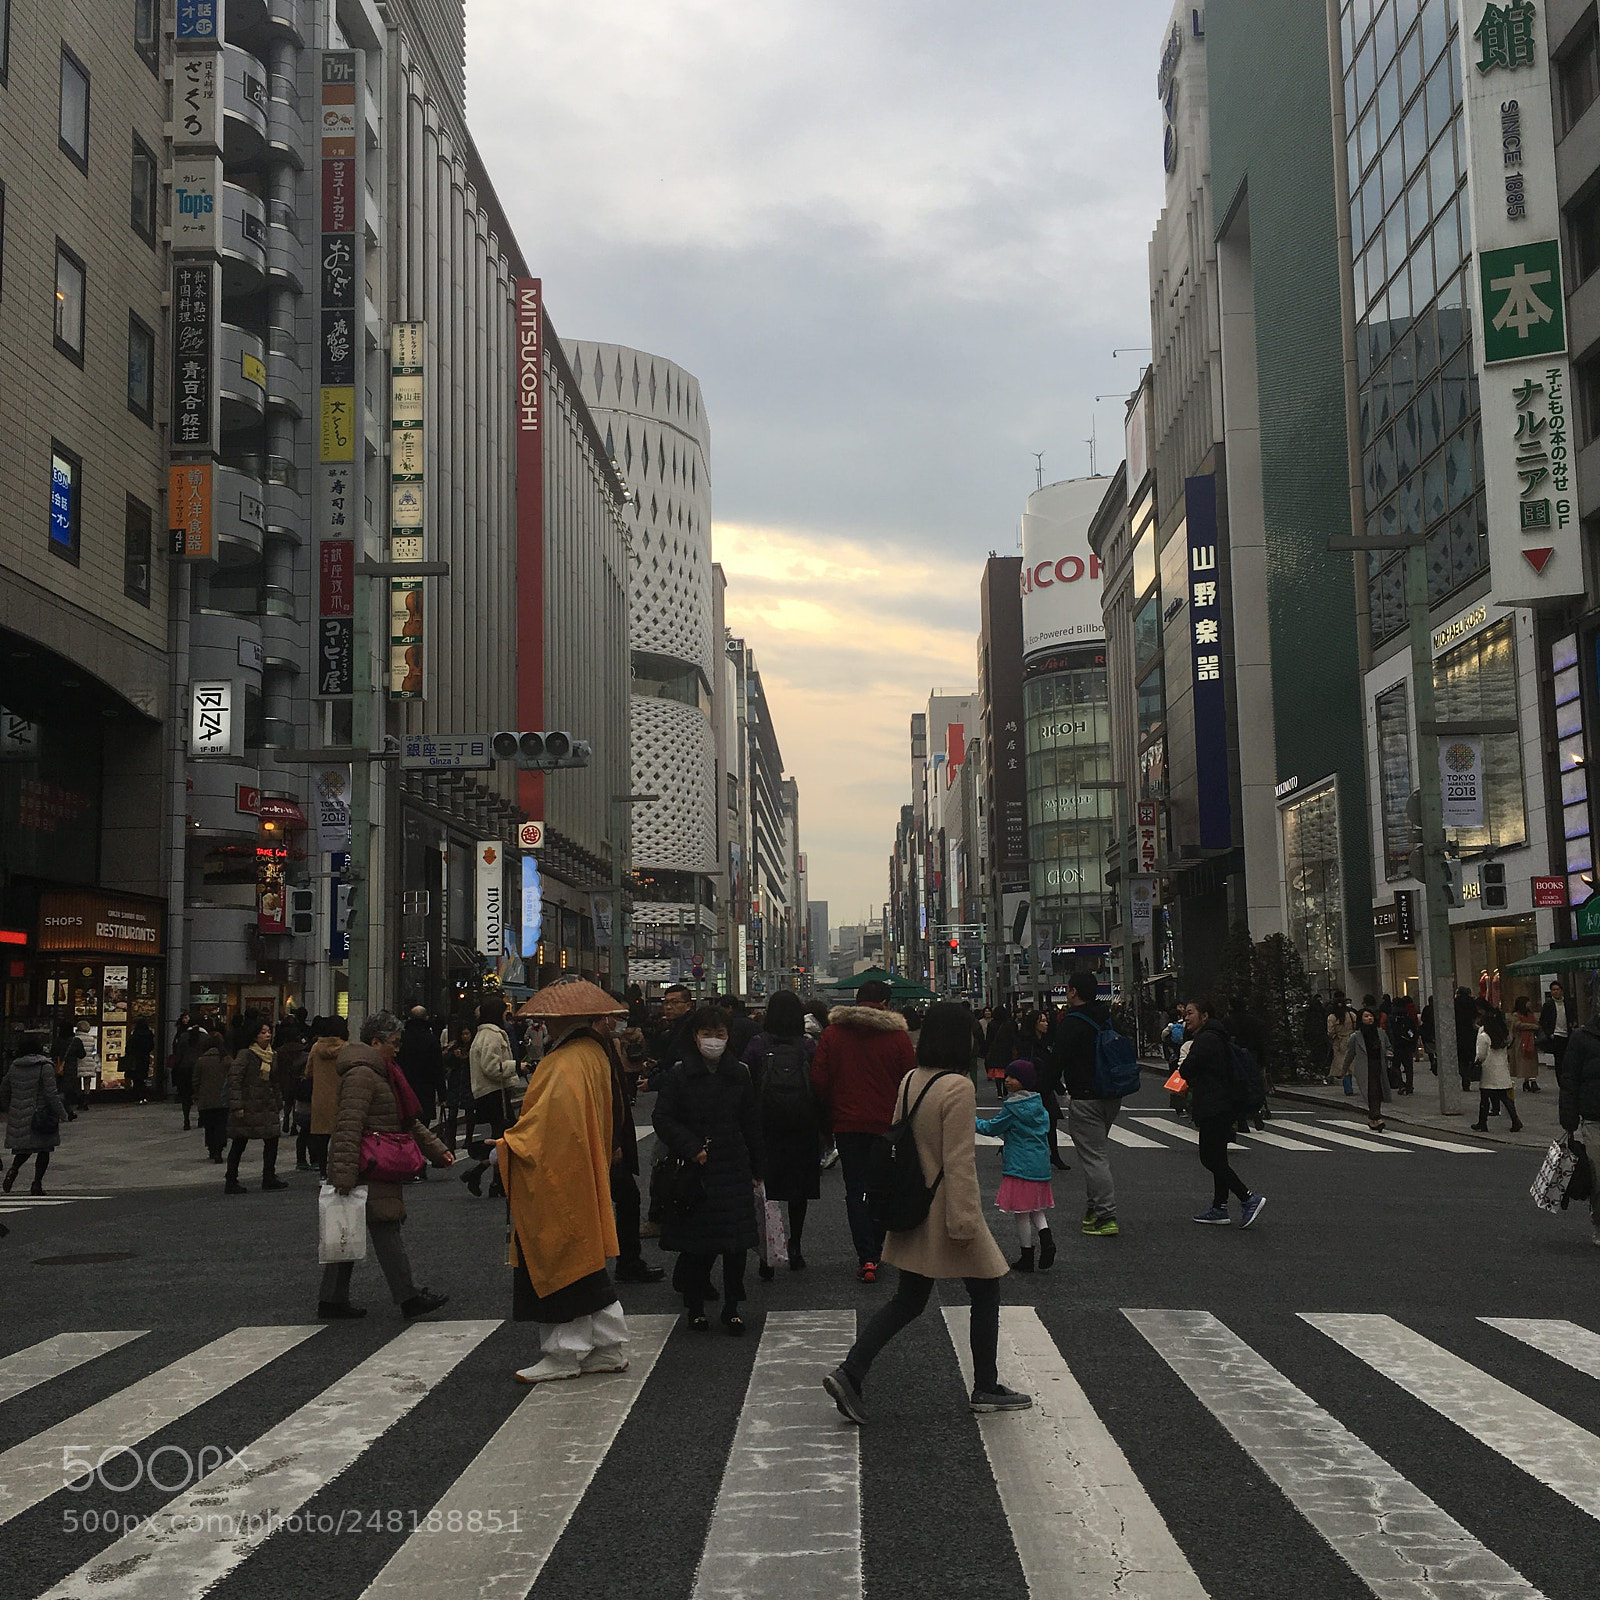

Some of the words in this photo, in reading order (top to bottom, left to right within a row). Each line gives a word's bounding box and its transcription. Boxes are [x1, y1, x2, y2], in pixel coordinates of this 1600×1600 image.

[1473, 0, 1536, 74] 館
[184, 61, 202, 135] ざくろ
[203, 61, 214, 99] 日本料理
[1501, 99, 1522, 165] SINCE
[1504, 171, 1525, 219] 1885
[183, 224, 206, 232] ケーキ
[179, 271, 191, 322] 中国料理
[1490, 262, 1554, 339] 本
[521, 289, 538, 431] MITSUKOSHI
[180, 361, 202, 441] 青百合飯荘
[1545, 368, 1569, 492] 子どもの本のみせ
[1512, 378, 1551, 532] ナルニア国
[188, 469, 203, 551] 輸入洋食器
[1556, 499, 1570, 529] 6F
[175, 531, 183, 552] 4F
[1192, 545, 1219, 681] 山野楽器
[1433, 622, 1464, 650] MICHAEL
[1464, 604, 1487, 631] KORS
[323, 621, 342, 692] コーヒー屋
[196, 687, 229, 741] IBIZA
[1042, 721, 1087, 739] RICOH
[406, 742, 483, 757] 銀座三丁目
[429, 757, 451, 765] Ginza
[1005, 720, 1018, 770] 鳩居堂
[1448, 787, 1476, 796] 2018
[322, 813, 345, 822] 2018
[1142, 829, 1155, 872] キムラヤ
[1536, 881, 1564, 890] BOOKS
[45, 916, 83, 926] SHOPS
[96, 922, 156, 942] RESTAURANTS
[487, 887, 500, 953] MOTOKI
[1401, 900, 1409, 934] ZENITH
